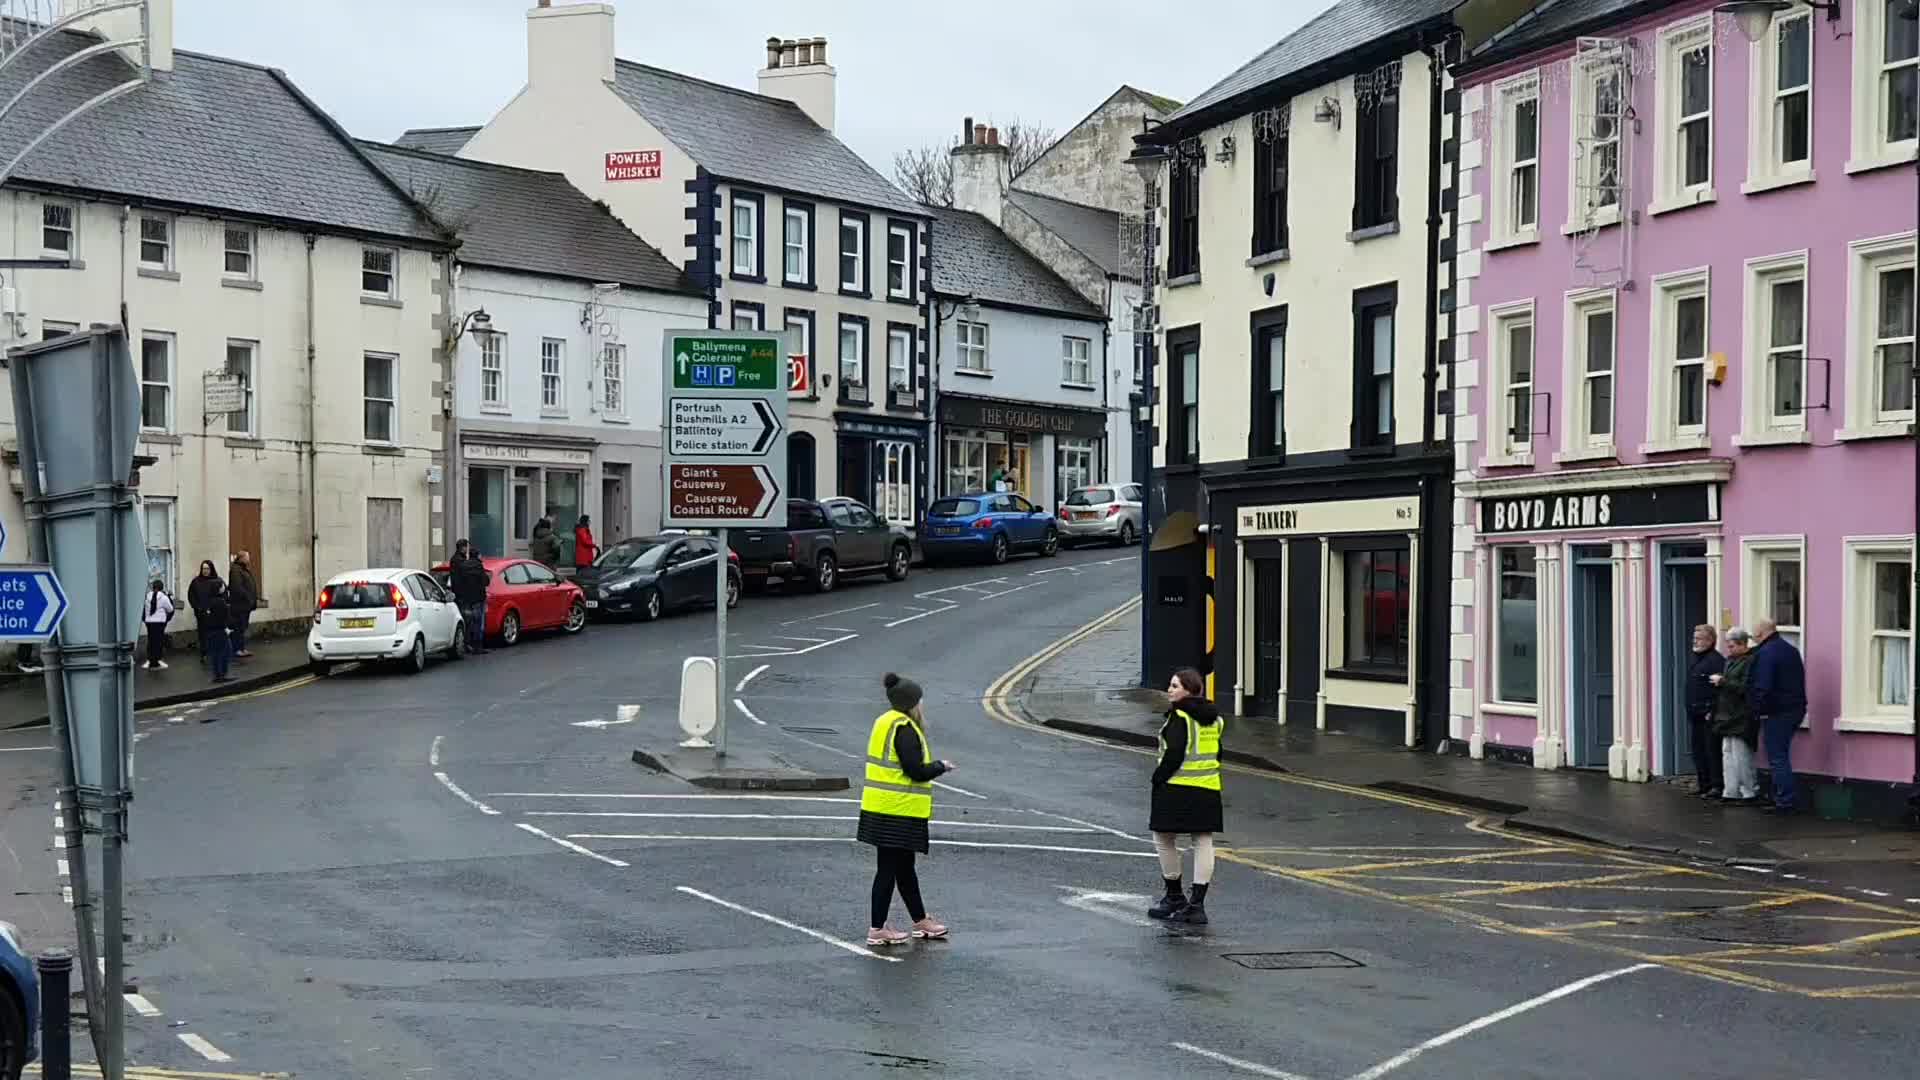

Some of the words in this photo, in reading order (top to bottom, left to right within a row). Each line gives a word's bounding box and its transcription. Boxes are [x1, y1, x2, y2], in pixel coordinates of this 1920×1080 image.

[609, 152, 657, 166] POWER'S
[606, 166, 660, 179] WHISKEY
[692, 341, 746, 352] Ballymena
[692, 353, 743, 363] Coleraine
[696, 366, 707, 378] H
[719, 367, 732, 384] P
[738, 371, 761, 380] Free
[675, 403, 722, 412] Portrush
[675, 414, 728, 424] Bushmills
[981, 408, 1001, 424] THE
[1005, 410, 1048, 430] GOLDEN
[1051, 415, 1074, 431] CHIP
[675, 426, 722, 436] Ballintoy
[675, 440, 708, 449] Police
[711, 440, 749, 449] station
[507, 447, 528, 458] STYLE
[681, 468, 718, 478] Giant's
[673, 480, 726, 490] Causeway
[685, 494, 738, 504] Causeway
[673, 505, 714, 514] Coastal
[718, 506, 749, 514] Route
[1494, 499, 1545, 530] BOYD
[1551, 494, 1611, 526] ARMS
[1243, 516, 1254, 528] THE
[1256, 510, 1298, 530] TANNERY
[0, 577, 27, 592] ets
[0, 595, 25, 610] ice
